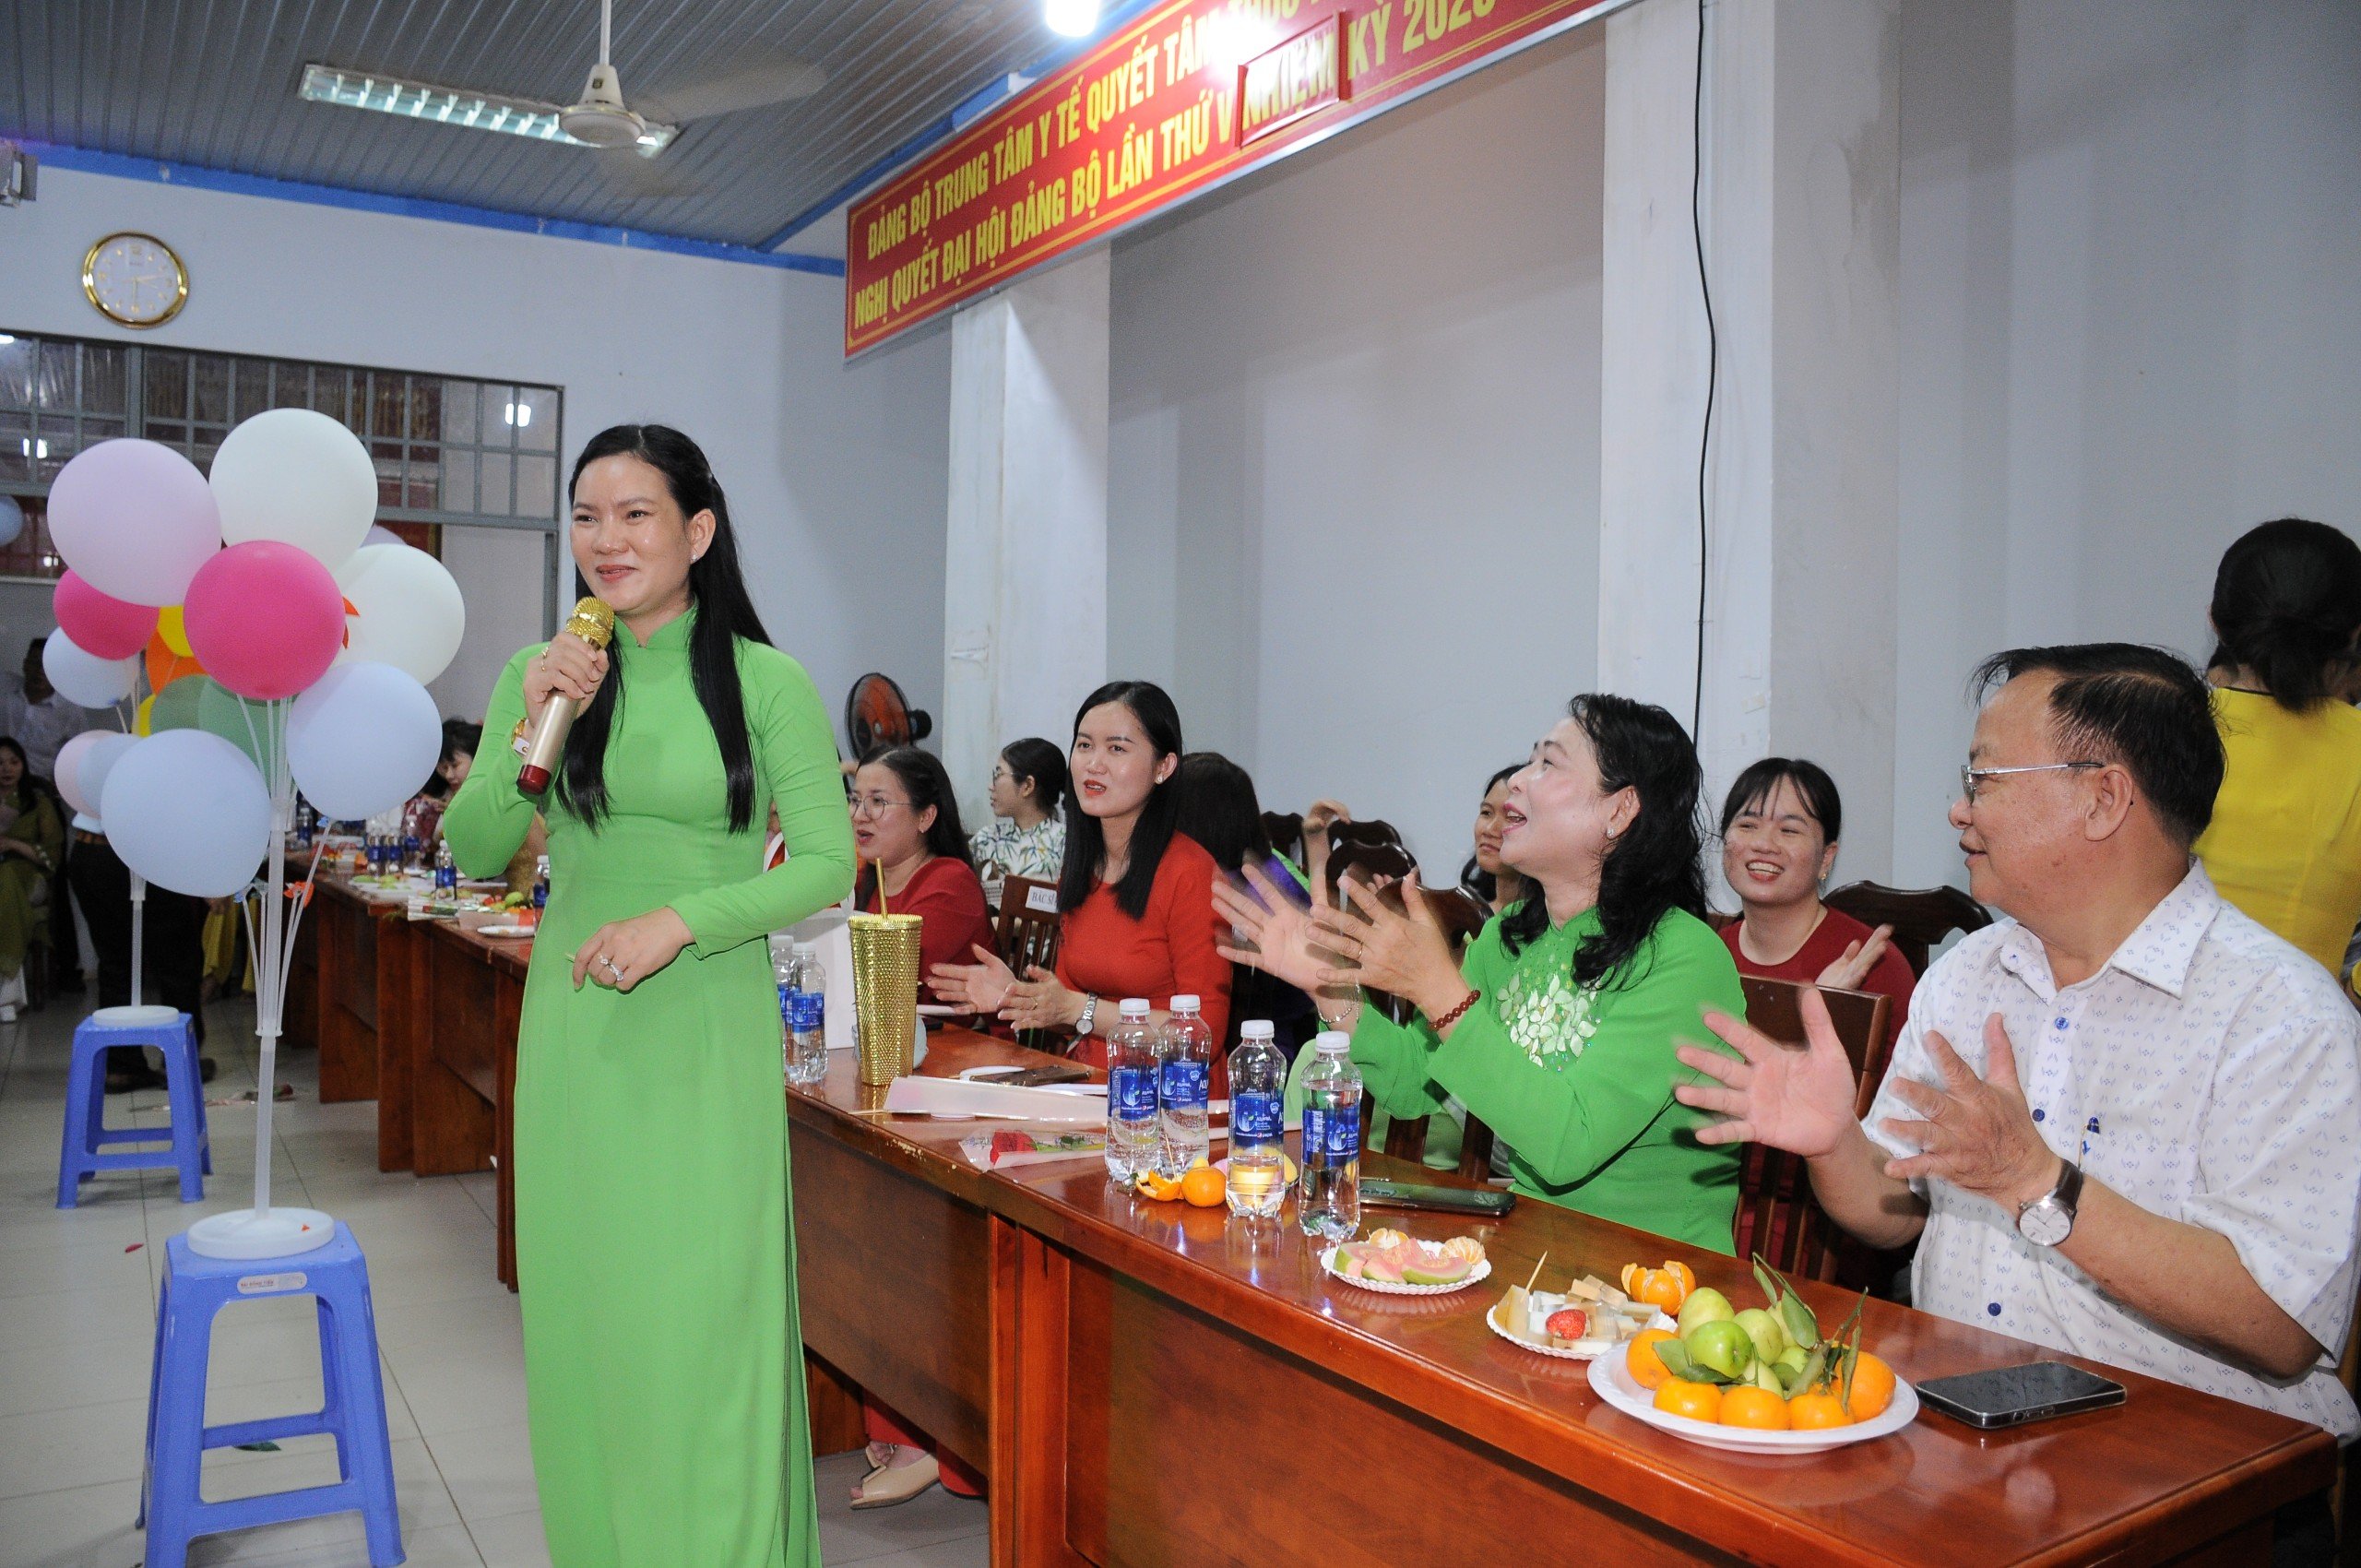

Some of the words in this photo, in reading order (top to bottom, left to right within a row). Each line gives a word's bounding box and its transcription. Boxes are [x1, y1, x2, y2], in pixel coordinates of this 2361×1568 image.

[855, 277, 888, 329] NGHỊ
[892, 238, 940, 313] QUYẾT
[942, 230, 971, 286] ĐẠI
[975, 206, 1006, 268] HỘI
[1010, 180, 1065, 248] ĐẢNG
[1071, 148, 1101, 220] BỘ
[1107, 122, 1153, 199] LẦN
[1160, 89, 1214, 172] THỨ
[868, 205, 907, 260] ĐẢNG
[910, 180, 931, 237] BỘ
[934, 150, 989, 220] TRUNG
[993, 122, 1034, 185] TÂM
[1038, 111, 1051, 159] Y
[1056, 75, 1084, 148] TẾ
[1086, 35, 1159, 134] QUYẾT
